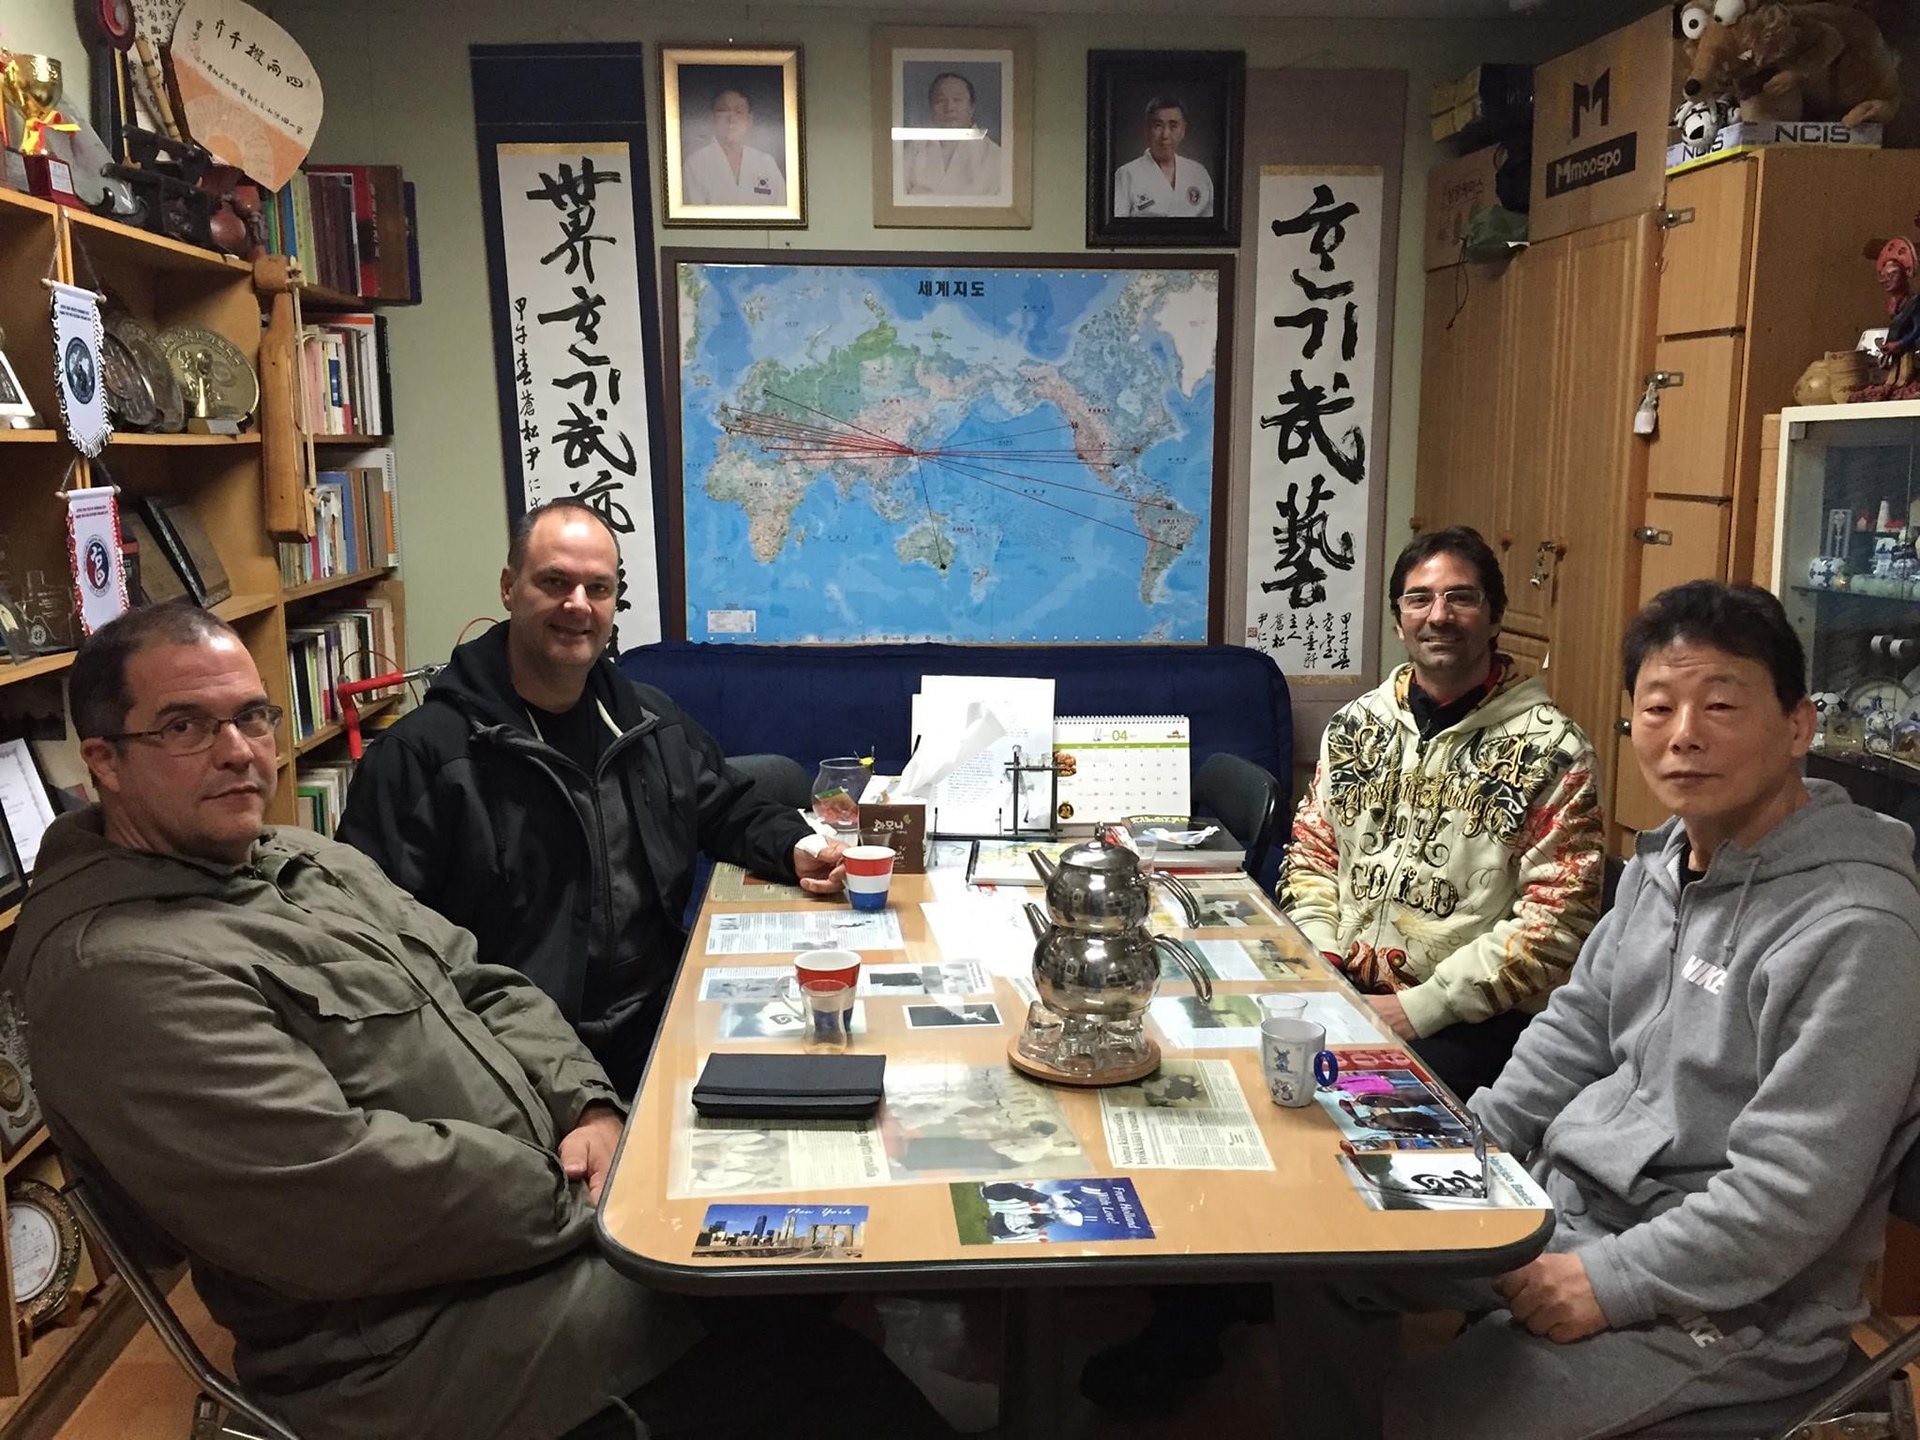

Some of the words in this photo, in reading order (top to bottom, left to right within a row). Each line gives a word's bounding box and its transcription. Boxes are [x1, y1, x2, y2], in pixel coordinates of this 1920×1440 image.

[1775, 124, 1851, 143] NCIS
[917, 280, 986, 299] 세계지도
[1111, 729, 1129, 742] 04
[1350, 863, 1460, 918] GOLD
[787, 1207, 815, 1216] New
[822, 1207, 853, 1217] York
